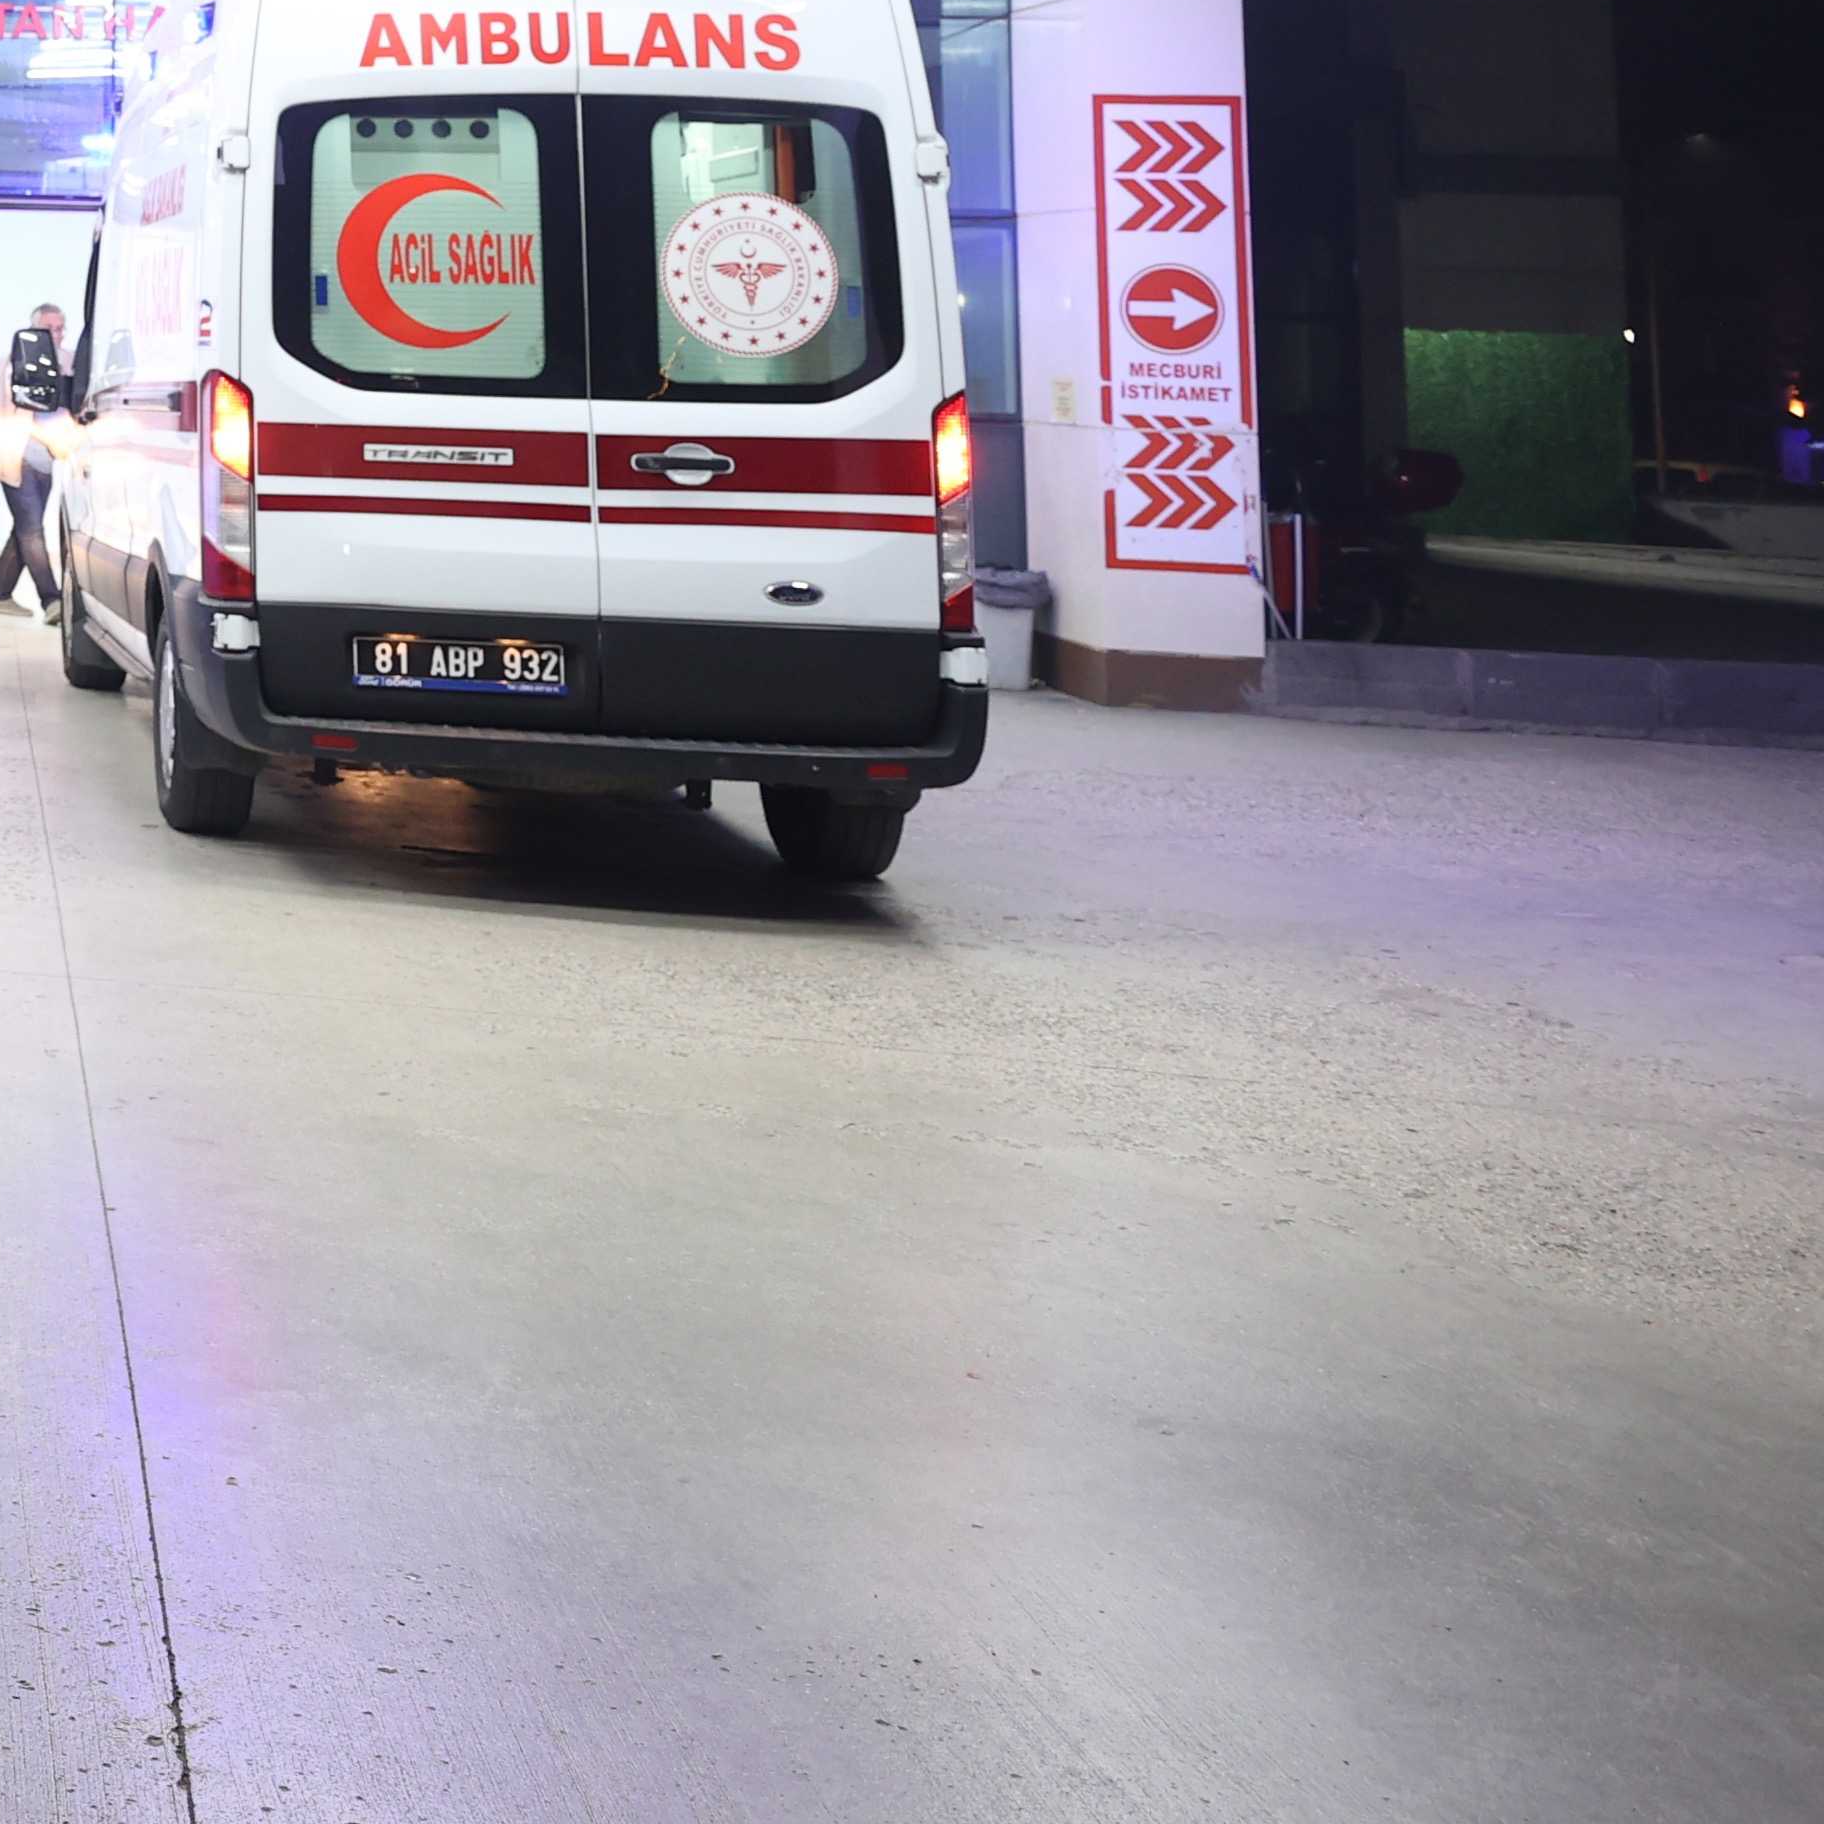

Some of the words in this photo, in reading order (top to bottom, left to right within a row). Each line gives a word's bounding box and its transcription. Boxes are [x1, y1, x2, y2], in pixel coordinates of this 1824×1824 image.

[359, 12, 801, 71] AMBULANS
[448, 229, 536, 286] SAĞLIK
[1129, 361, 1222, 380] MECBURİ
[1120, 381, 1232, 403] İSTİKAMET
[366, 447, 509, 463] TRANSIT
[374, 642, 409, 674] 81
[429, 645, 485, 678] ABP
[502, 646, 560, 683] 932
